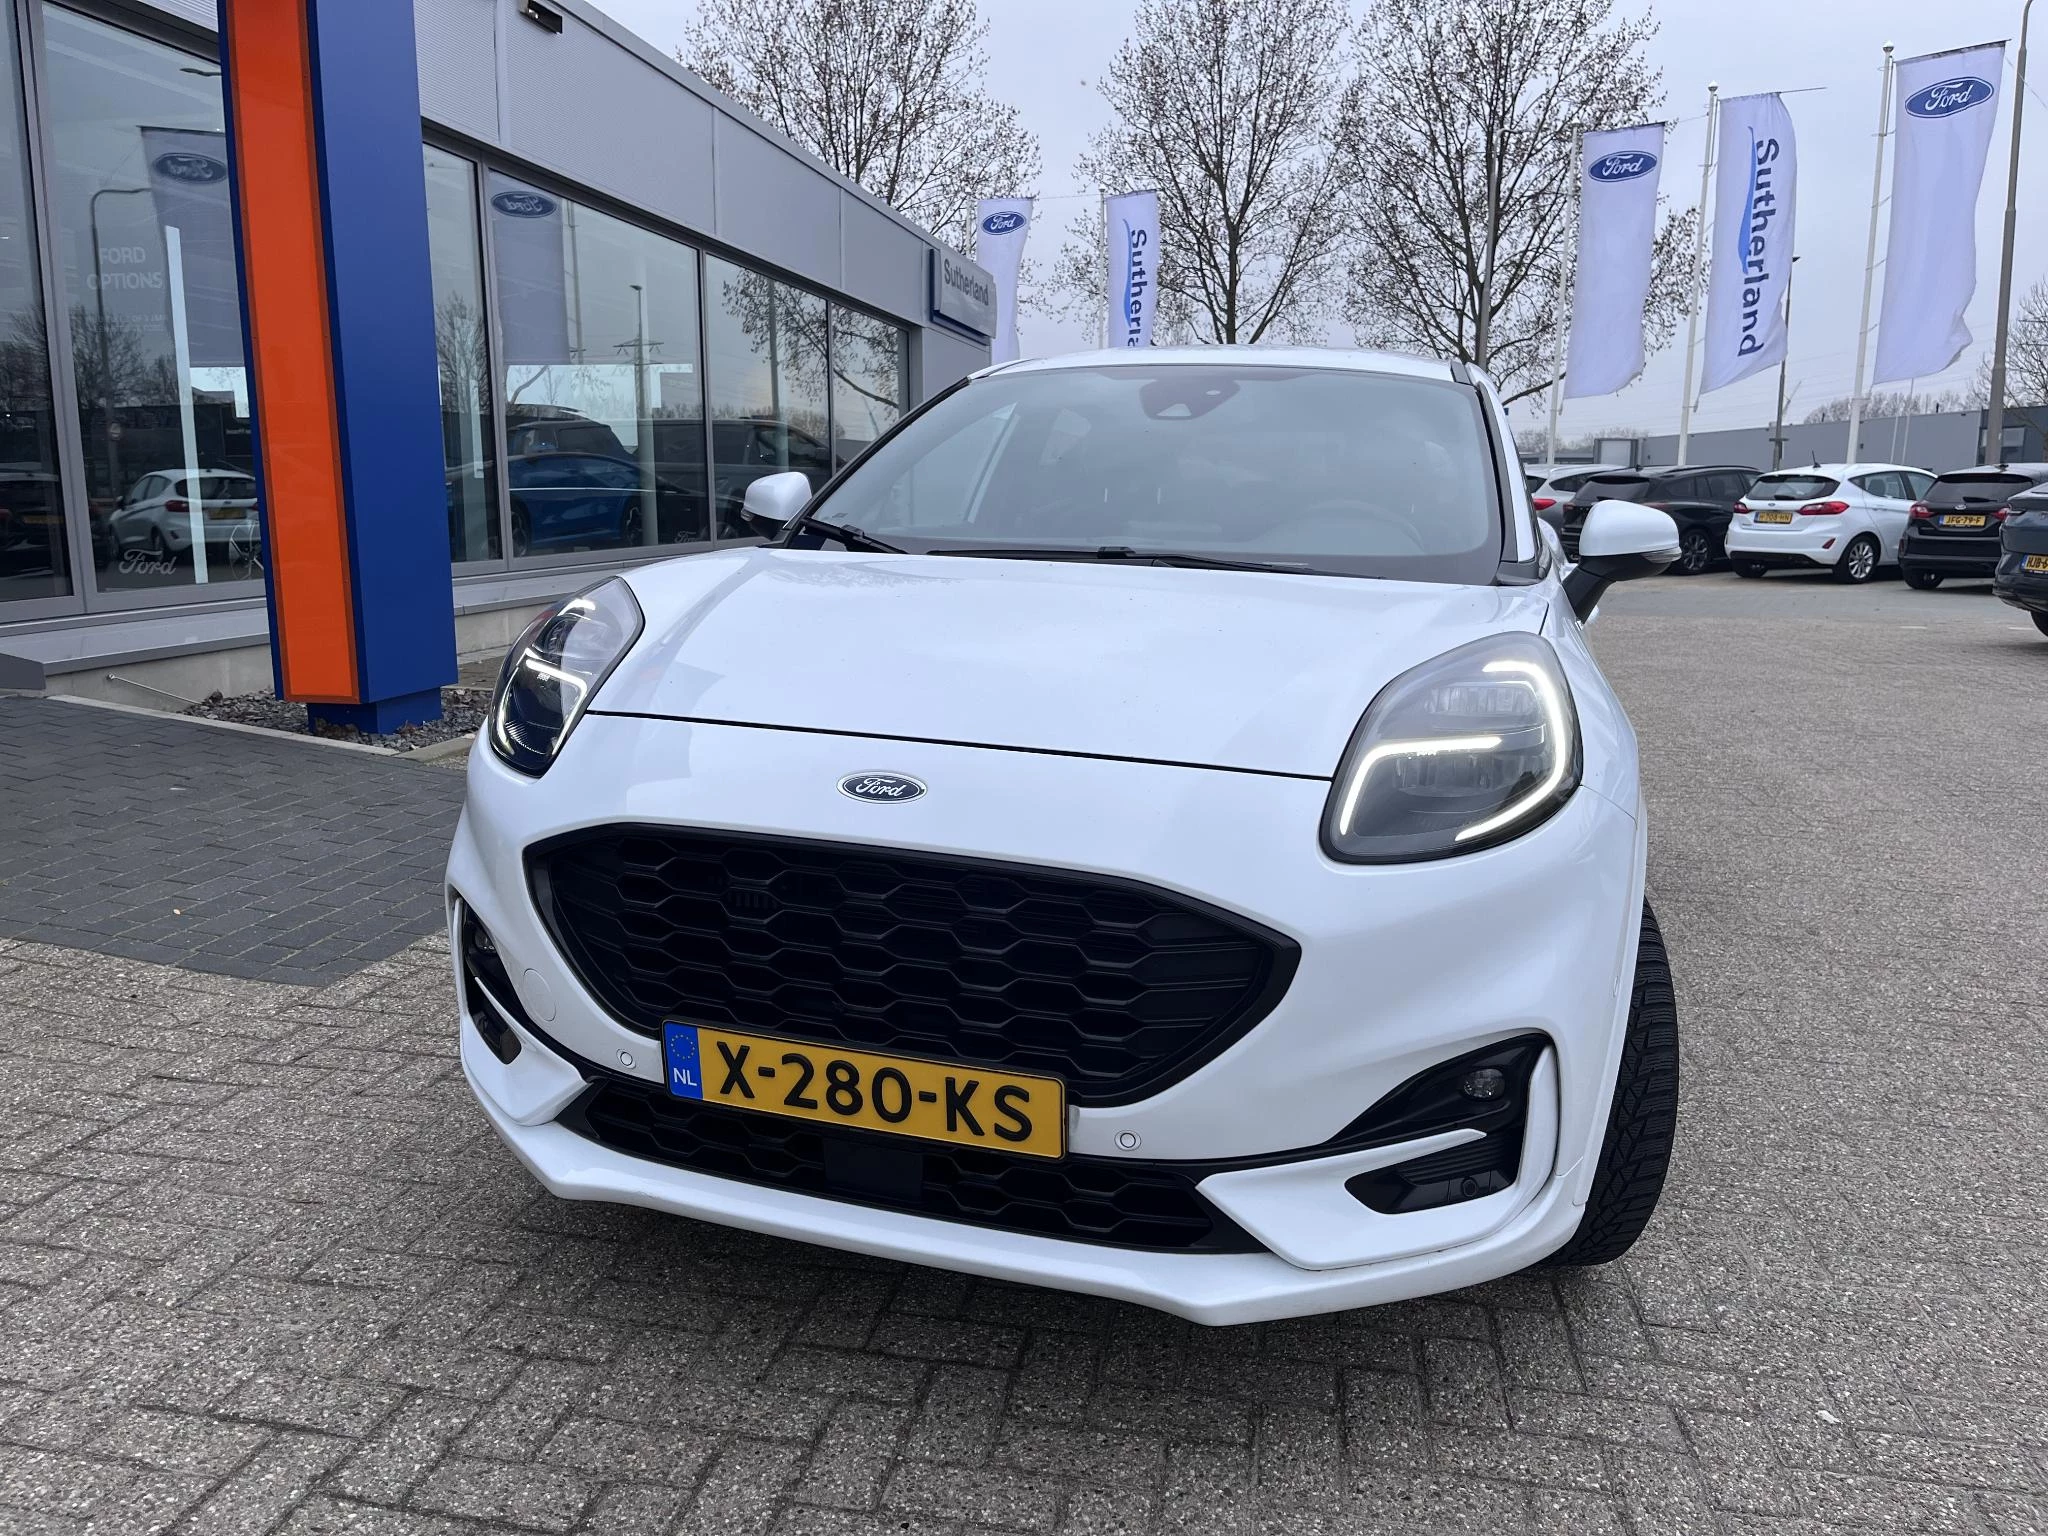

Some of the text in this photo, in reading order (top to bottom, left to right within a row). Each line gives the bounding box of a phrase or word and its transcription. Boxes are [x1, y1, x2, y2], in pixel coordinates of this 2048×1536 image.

[1925, 82, 1974, 111] Ford
[1602, 154, 1645, 177] Ford
[990, 214, 1017, 231] Ford
[99, 246, 146, 264] FORD
[1738, 138, 1780, 357] Sutherland
[86, 271, 163, 290] OPTIONS
[943, 258, 989, 306] Sutherland
[119, 548, 177, 575] Ford
[855, 777, 907, 797] Ford
[673, 1040, 1033, 1143] NL X-280-KS
